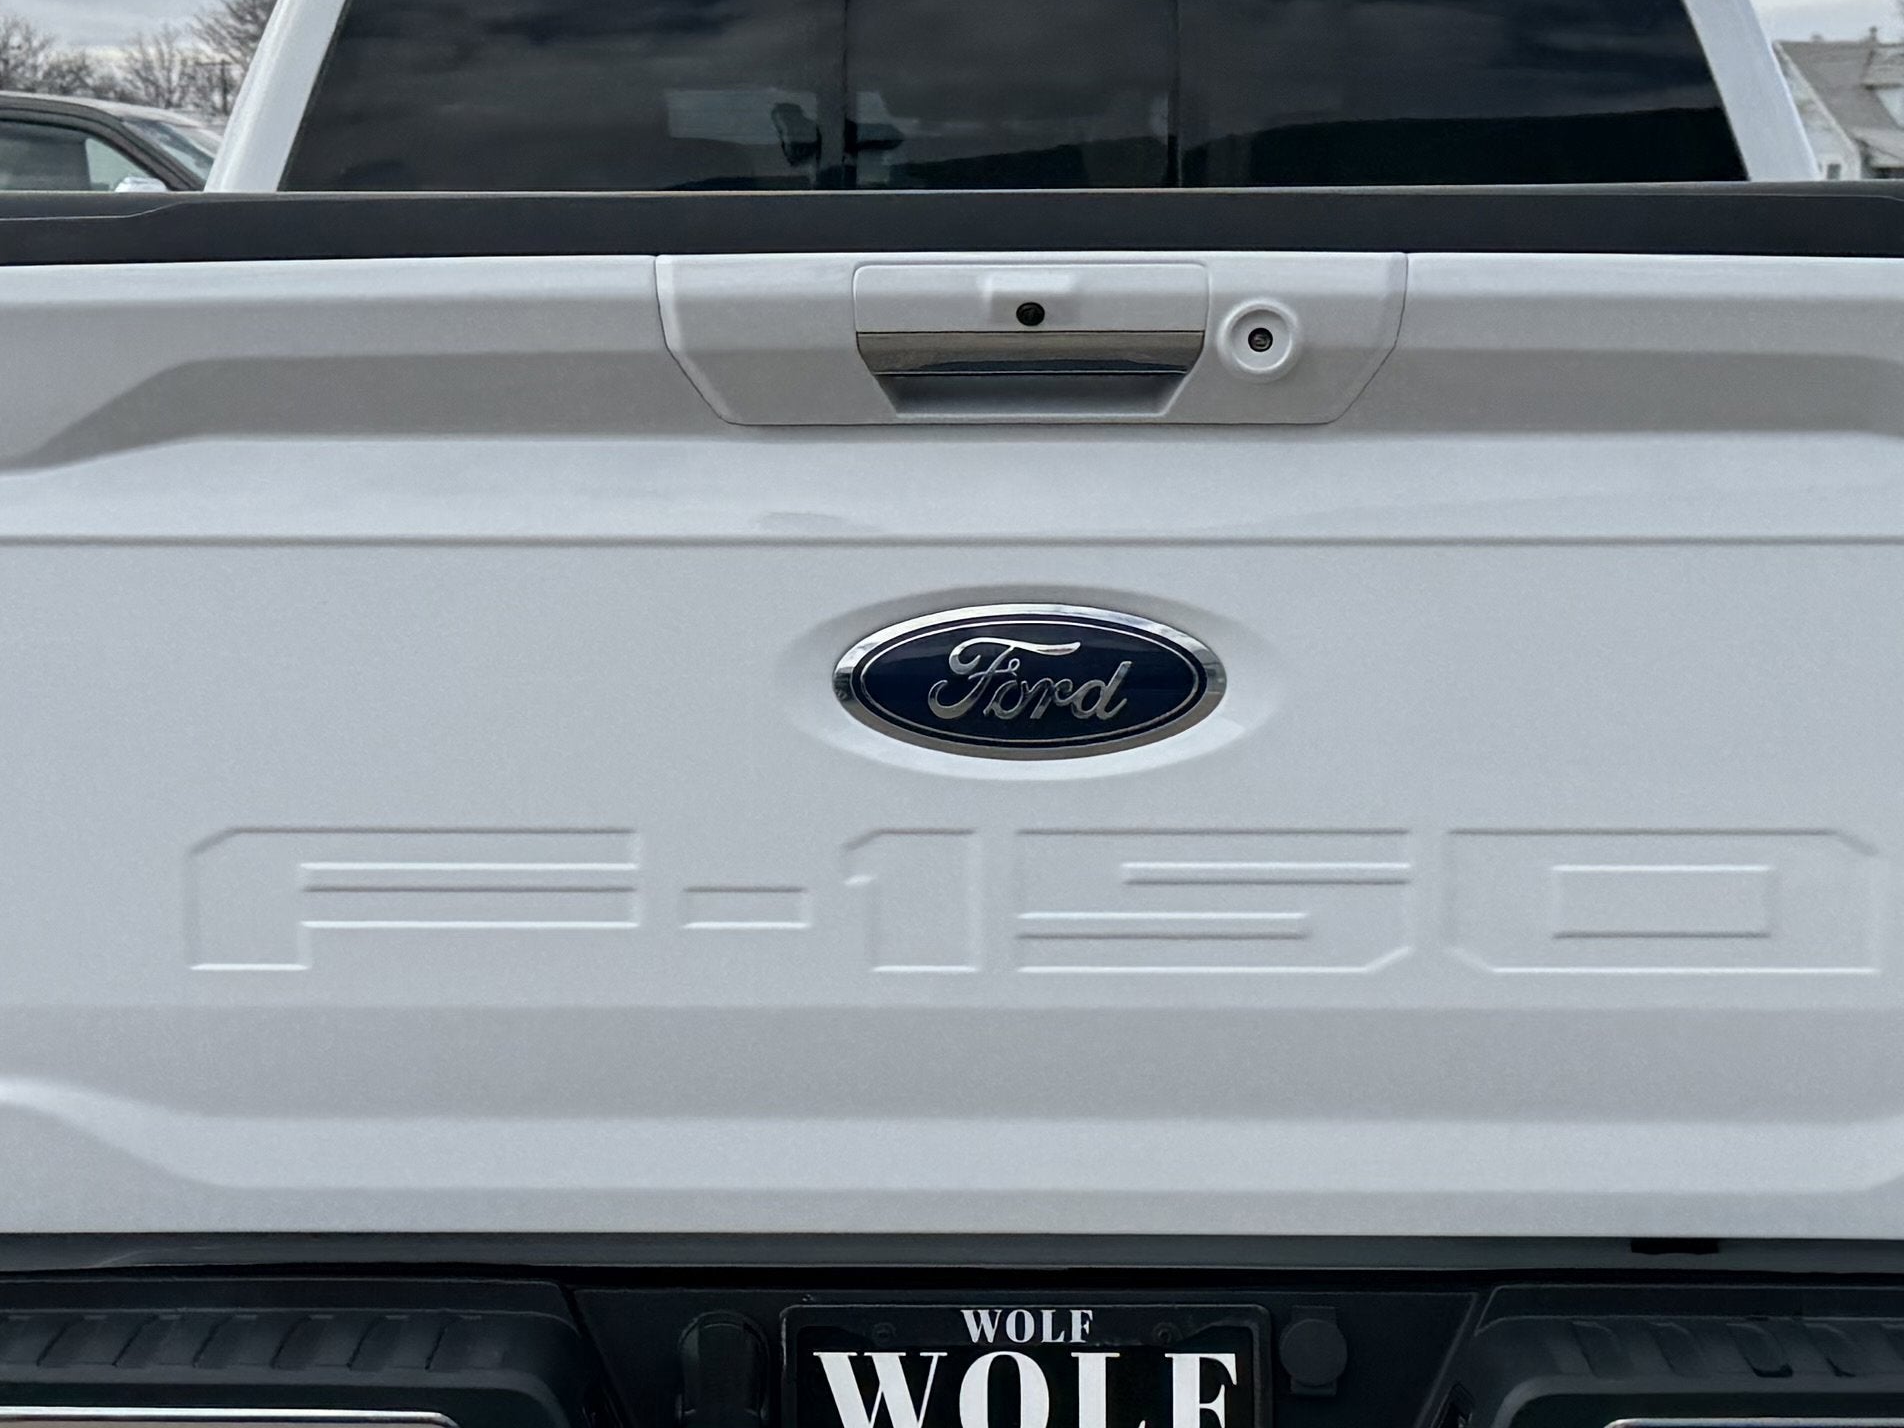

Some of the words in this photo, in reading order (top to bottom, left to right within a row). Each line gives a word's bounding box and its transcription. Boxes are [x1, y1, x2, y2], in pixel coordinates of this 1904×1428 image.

[927, 637, 1133, 721] Ford
[186, 826, 1882, 974] F-150
[961, 1309, 1093, 1343] WOLF
